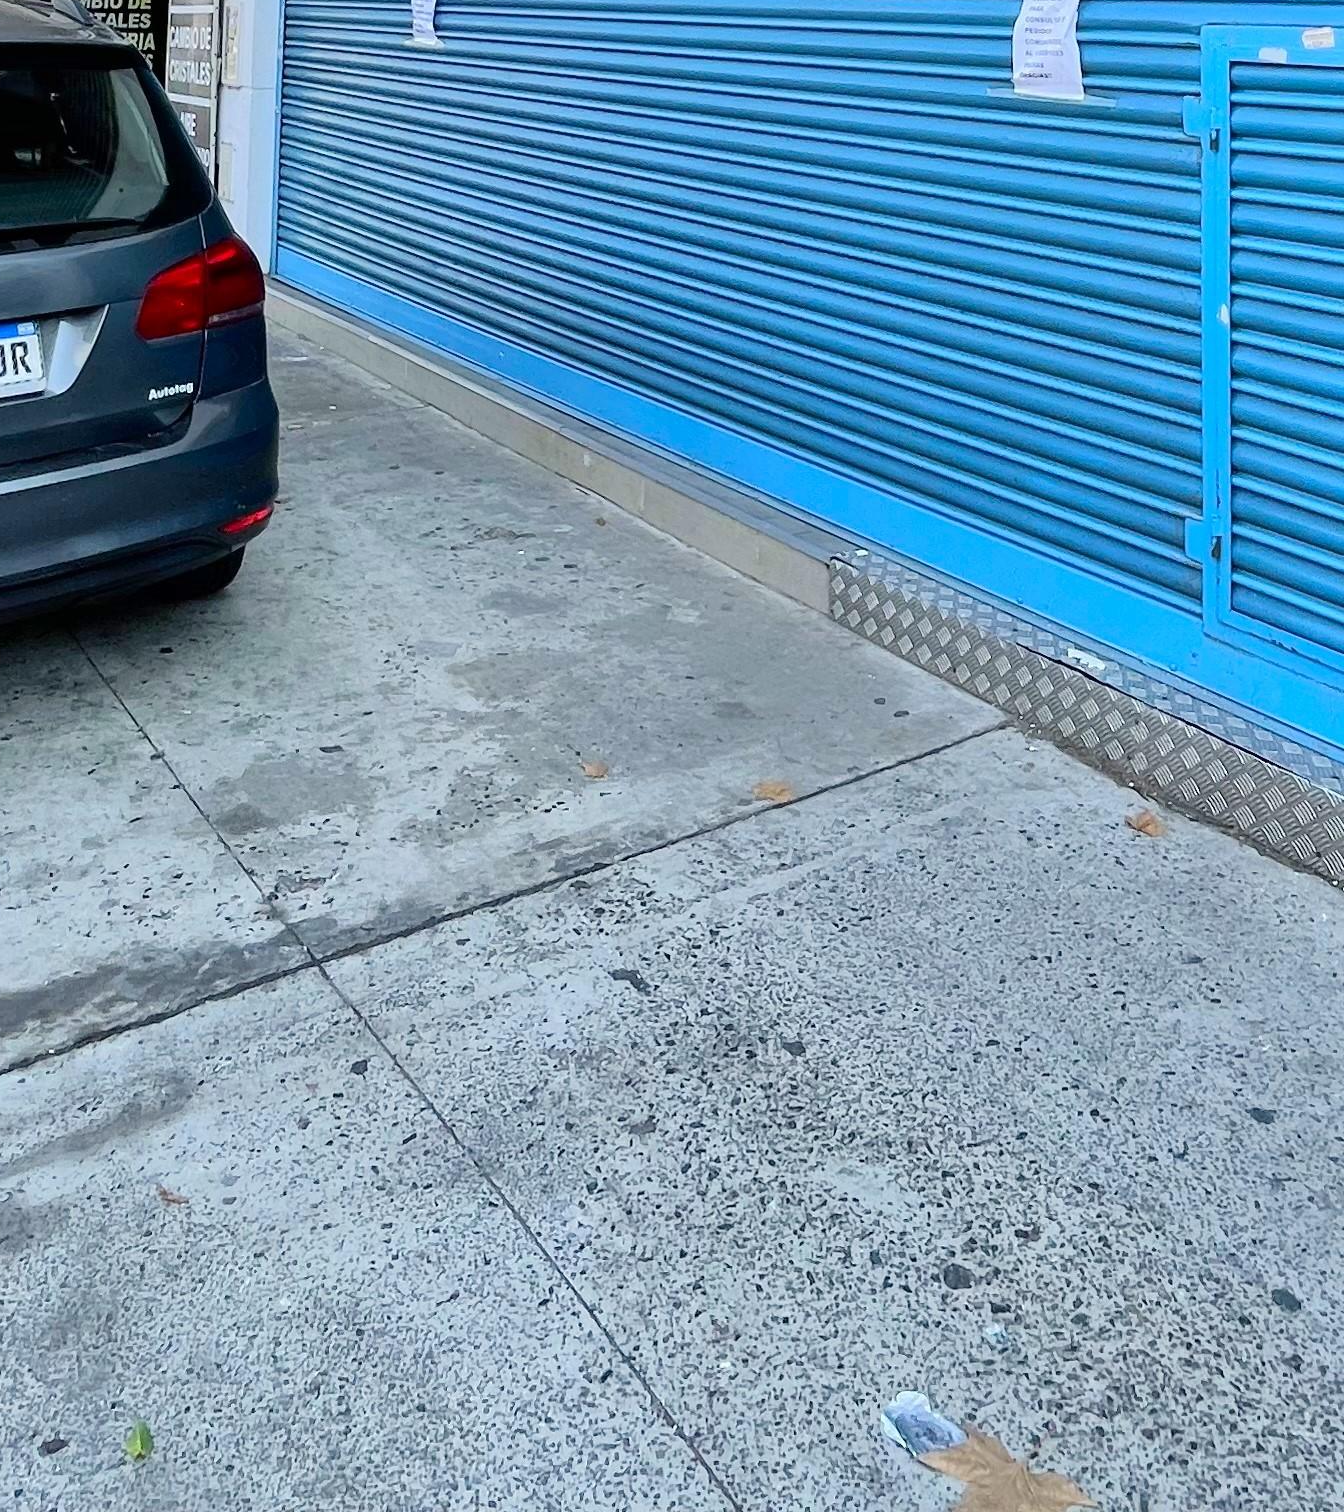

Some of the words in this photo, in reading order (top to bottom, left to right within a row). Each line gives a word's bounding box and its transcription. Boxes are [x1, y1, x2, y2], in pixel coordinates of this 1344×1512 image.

[170, 26, 199, 50] CAMBIO
[199, 27, 212, 51] DE
[169, 59, 212, 87] CRISTALES
[148, 382, 194, 401] Autotag
